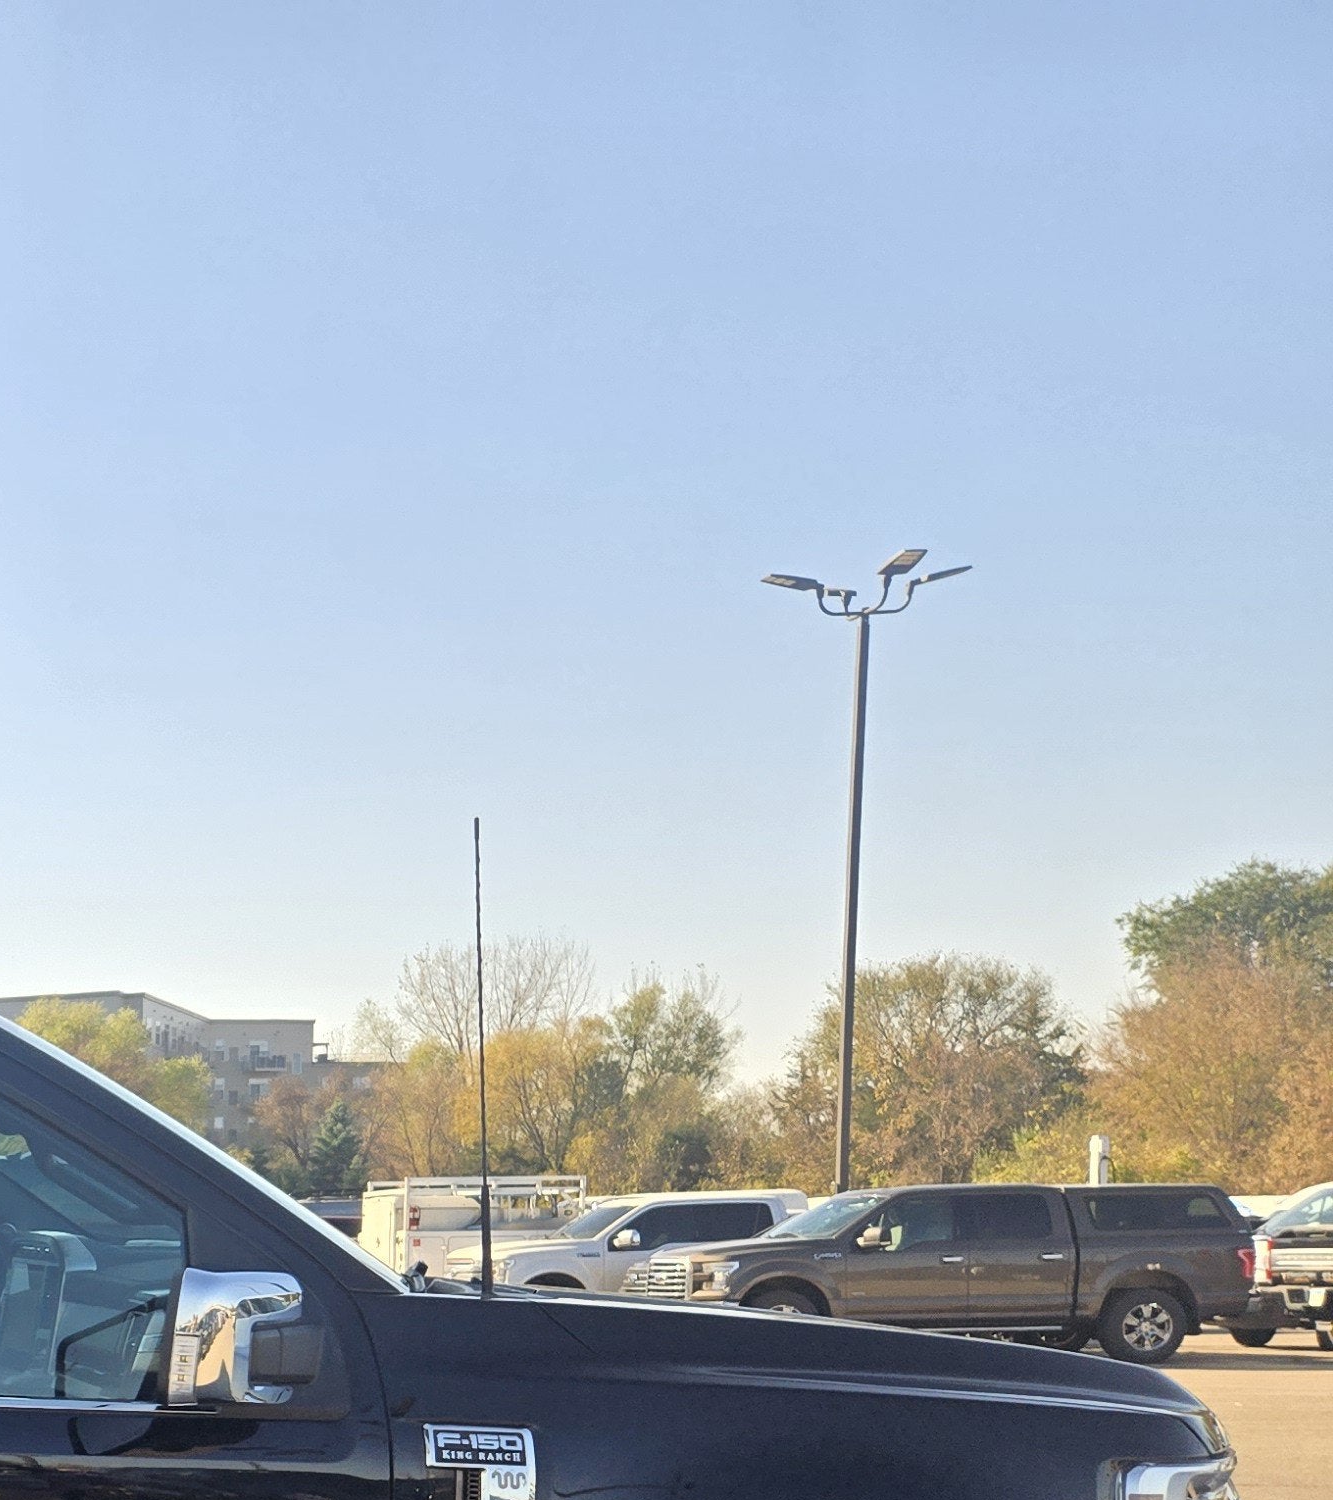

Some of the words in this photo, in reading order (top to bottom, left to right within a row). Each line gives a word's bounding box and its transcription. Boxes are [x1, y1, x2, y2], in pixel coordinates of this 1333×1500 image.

[436, 1432, 523, 1451] F-150
[442, 1450, 473, 1460] KING
[478, 1452, 521, 1462] RANCH
